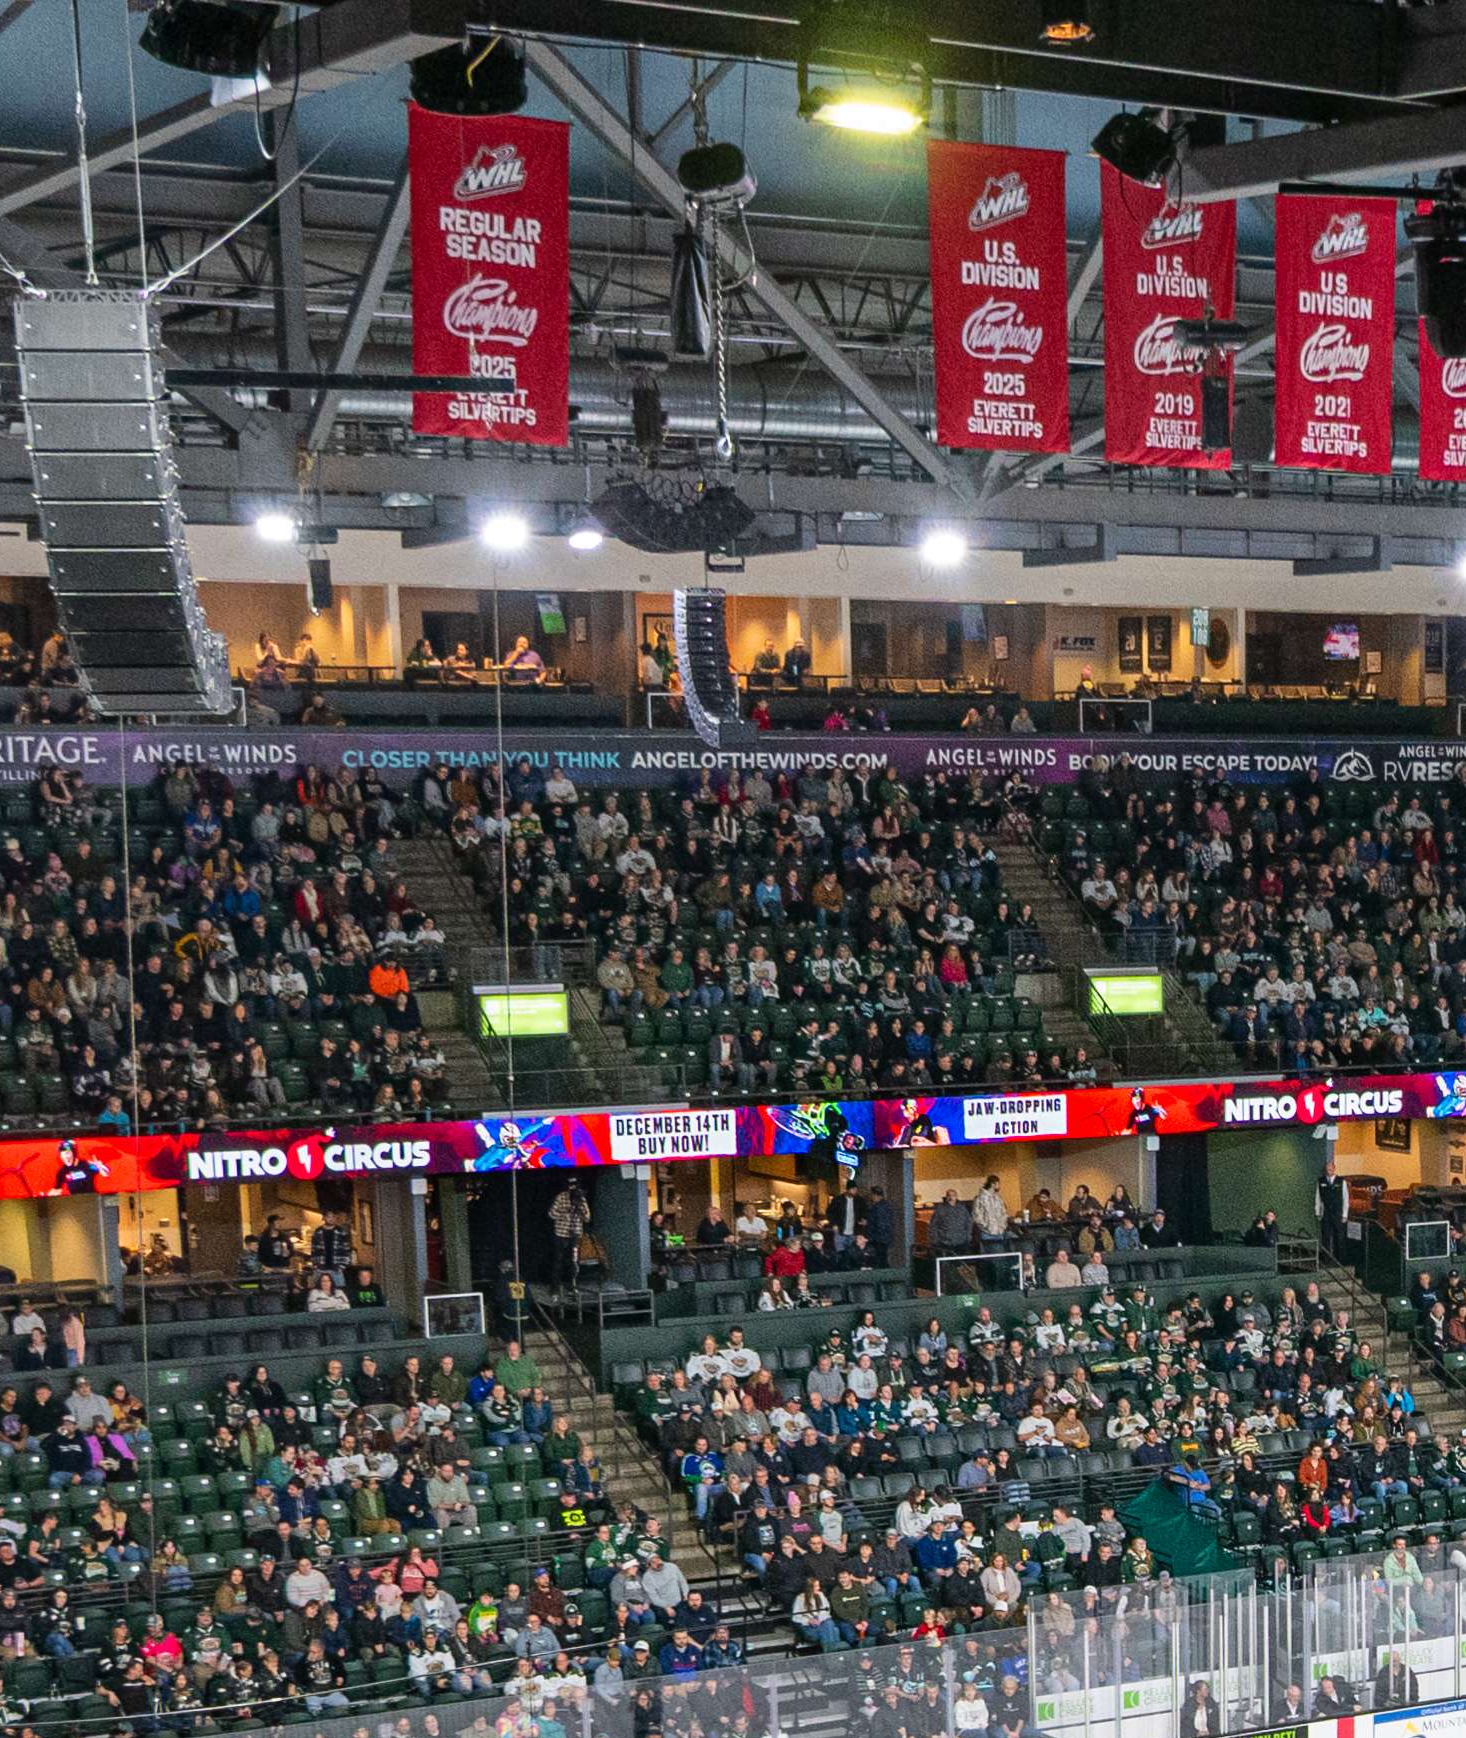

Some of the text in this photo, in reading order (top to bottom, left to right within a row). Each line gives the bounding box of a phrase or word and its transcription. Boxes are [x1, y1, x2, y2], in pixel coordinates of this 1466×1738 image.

[439, 207, 541, 243] REGULAR
[446, 237, 535, 268] SEASON
[985, 240, 1020, 264] U.S.
[961, 262, 1040, 290] DIVISION
[1156, 255, 1187, 277] U.S.
[1137, 273, 1208, 298] DIVISION
[444, 273, 538, 347] Champions
[1299, 292, 1372, 319] DIVISION
[962, 297, 1042, 363] Champions
[1300, 322, 1369, 383] Champions
[984, 373, 1025, 396] 2025
[447, 402, 536, 427] SILVERTIPS
[974, 399, 1035, 420] EVERETT
[1155, 393, 1194, 415] 2019
[1315, 396, 1350, 418] 2021
[968, 417, 1043, 439] SILVERTIPS
[1150, 419, 1197, 435] EVERETT
[1307, 422, 1360, 440] EVERETT
[1146, 431, 1202, 450] SILVERTIPS
[1302, 438, 1367, 457] SILVERTIPS
[133, 744, 297, 763] ANGEL WINDS
[341, 750, 620, 769] CLOSER THAN YOU THINK
[926, 749, 984, 765] ANGEL
[999, 749, 1056, 765] WINDS
[1399, 745, 1437, 757] ANGEL
[1183, 755, 1318, 772] ESCAPE TODAY!
[967, 1099, 1062, 1117] JAW-DROPPING
[1224, 1090, 1402, 1122] NITRO CIRCUS
[615, 1113, 730, 1137] DECEMBER 14TH
[993, 1119, 1039, 1135] ACTION
[638, 1135, 710, 1155] BUY NOW!
[189, 1139, 431, 1181] NITRO CIRCUS
